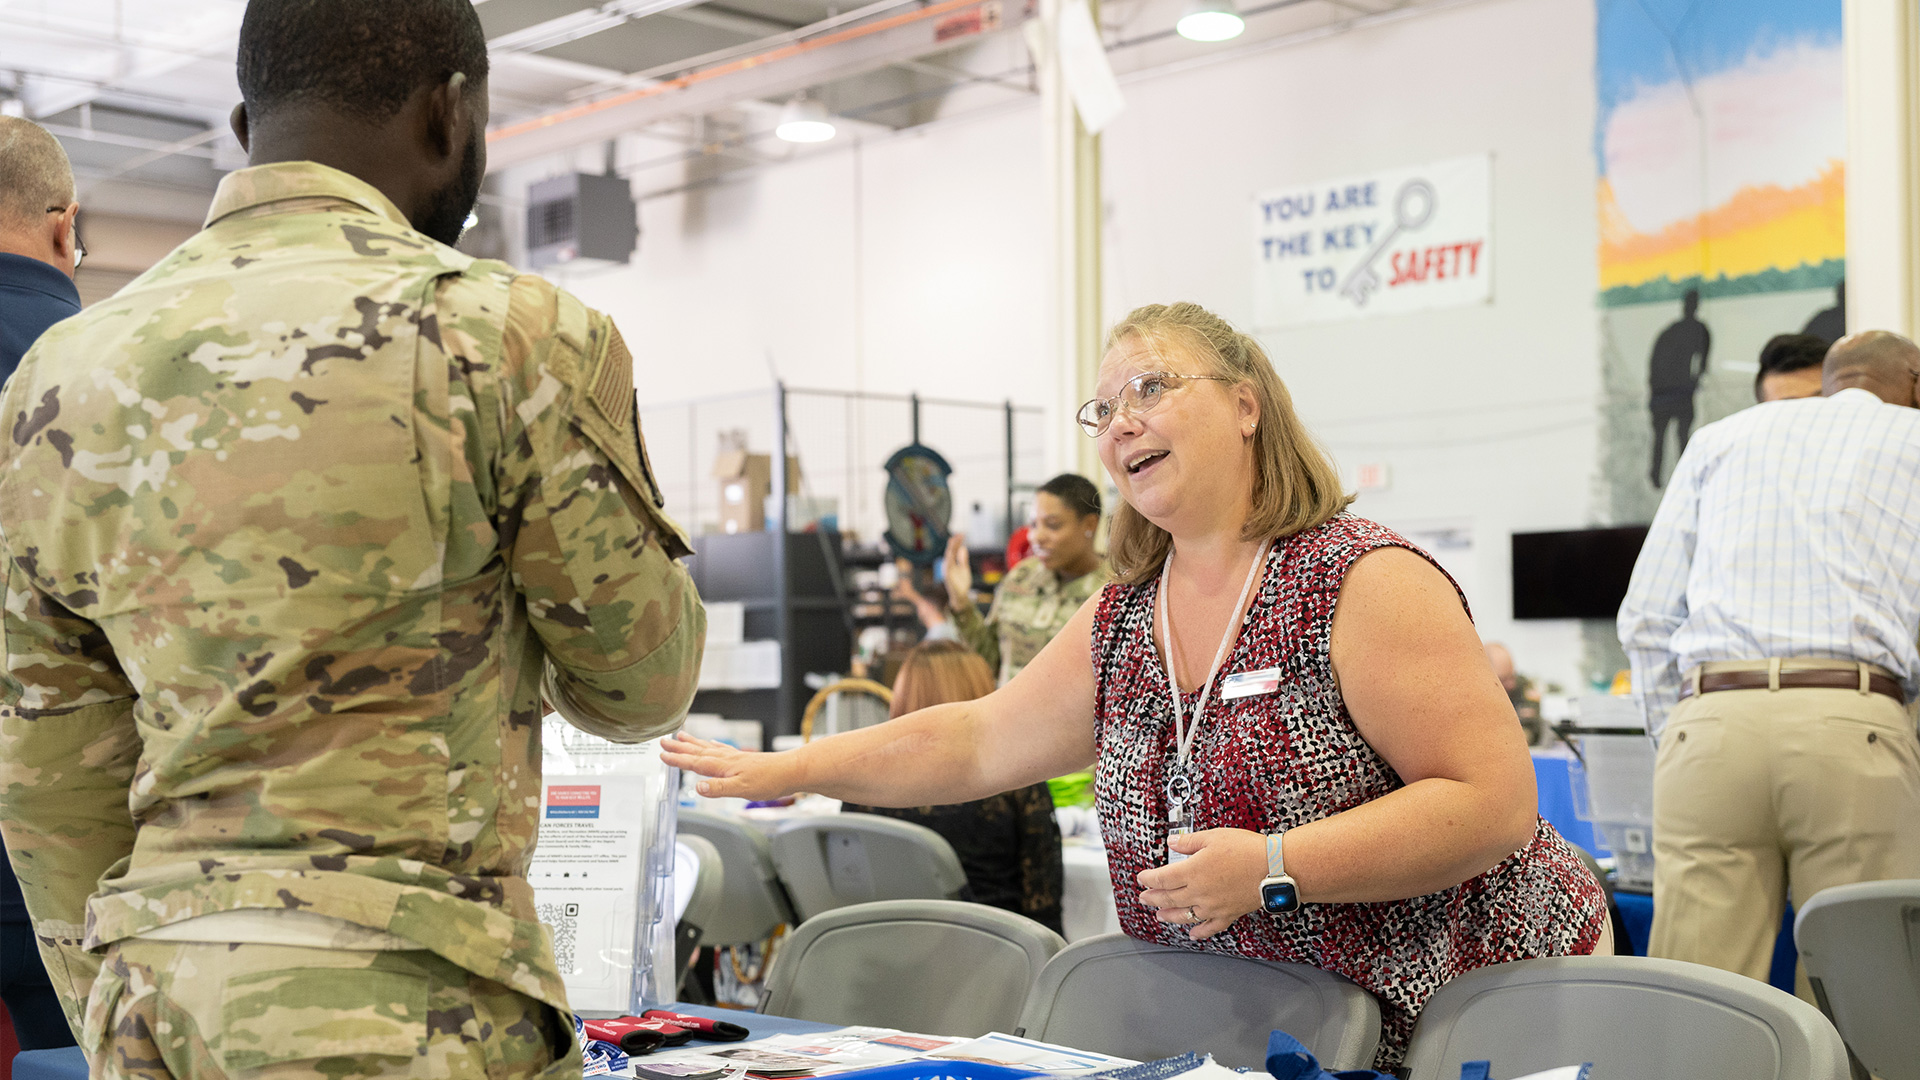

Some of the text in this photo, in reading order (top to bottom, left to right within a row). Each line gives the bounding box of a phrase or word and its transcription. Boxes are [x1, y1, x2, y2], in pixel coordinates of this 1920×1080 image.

[1262, 181, 1377, 221] YOU ARE
[1262, 221, 1378, 260] THE KEY
[1303, 267, 1337, 292] TO
[1388, 238, 1483, 287] SAFETY
